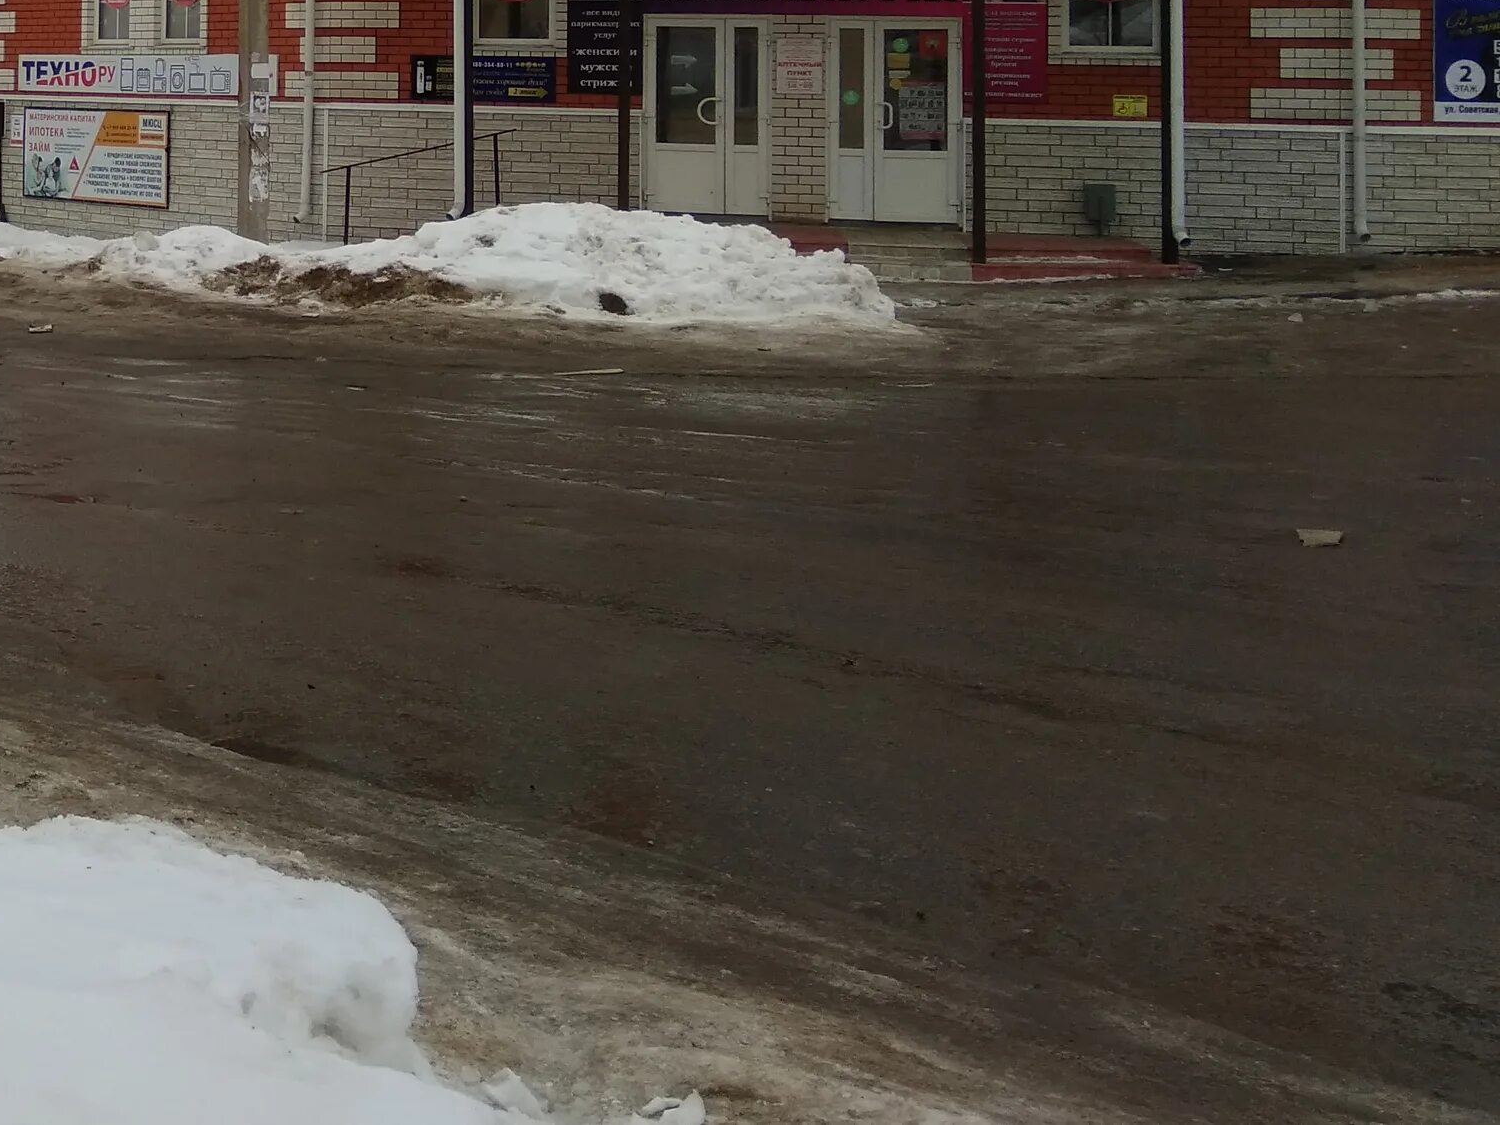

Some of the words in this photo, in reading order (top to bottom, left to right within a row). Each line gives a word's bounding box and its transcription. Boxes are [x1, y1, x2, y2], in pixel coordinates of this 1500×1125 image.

[575, 48, 620, 56] женски
[580, 64, 632, 73] мужск
[1460, 66, 1472, 82] 2
[580, 79, 632, 89] стриж
[1454, 85, 1478, 93] ЭТАЖ
[29, 113, 69, 122] МАТЕРИНСКИЙ
[69, 114, 96, 123] КАПИТАЛ
[142, 118, 162, 129] МЮСЦ
[29, 127, 64, 138] ИПОТЕКА
[28, 142, 51, 153] ЗАЙМ
